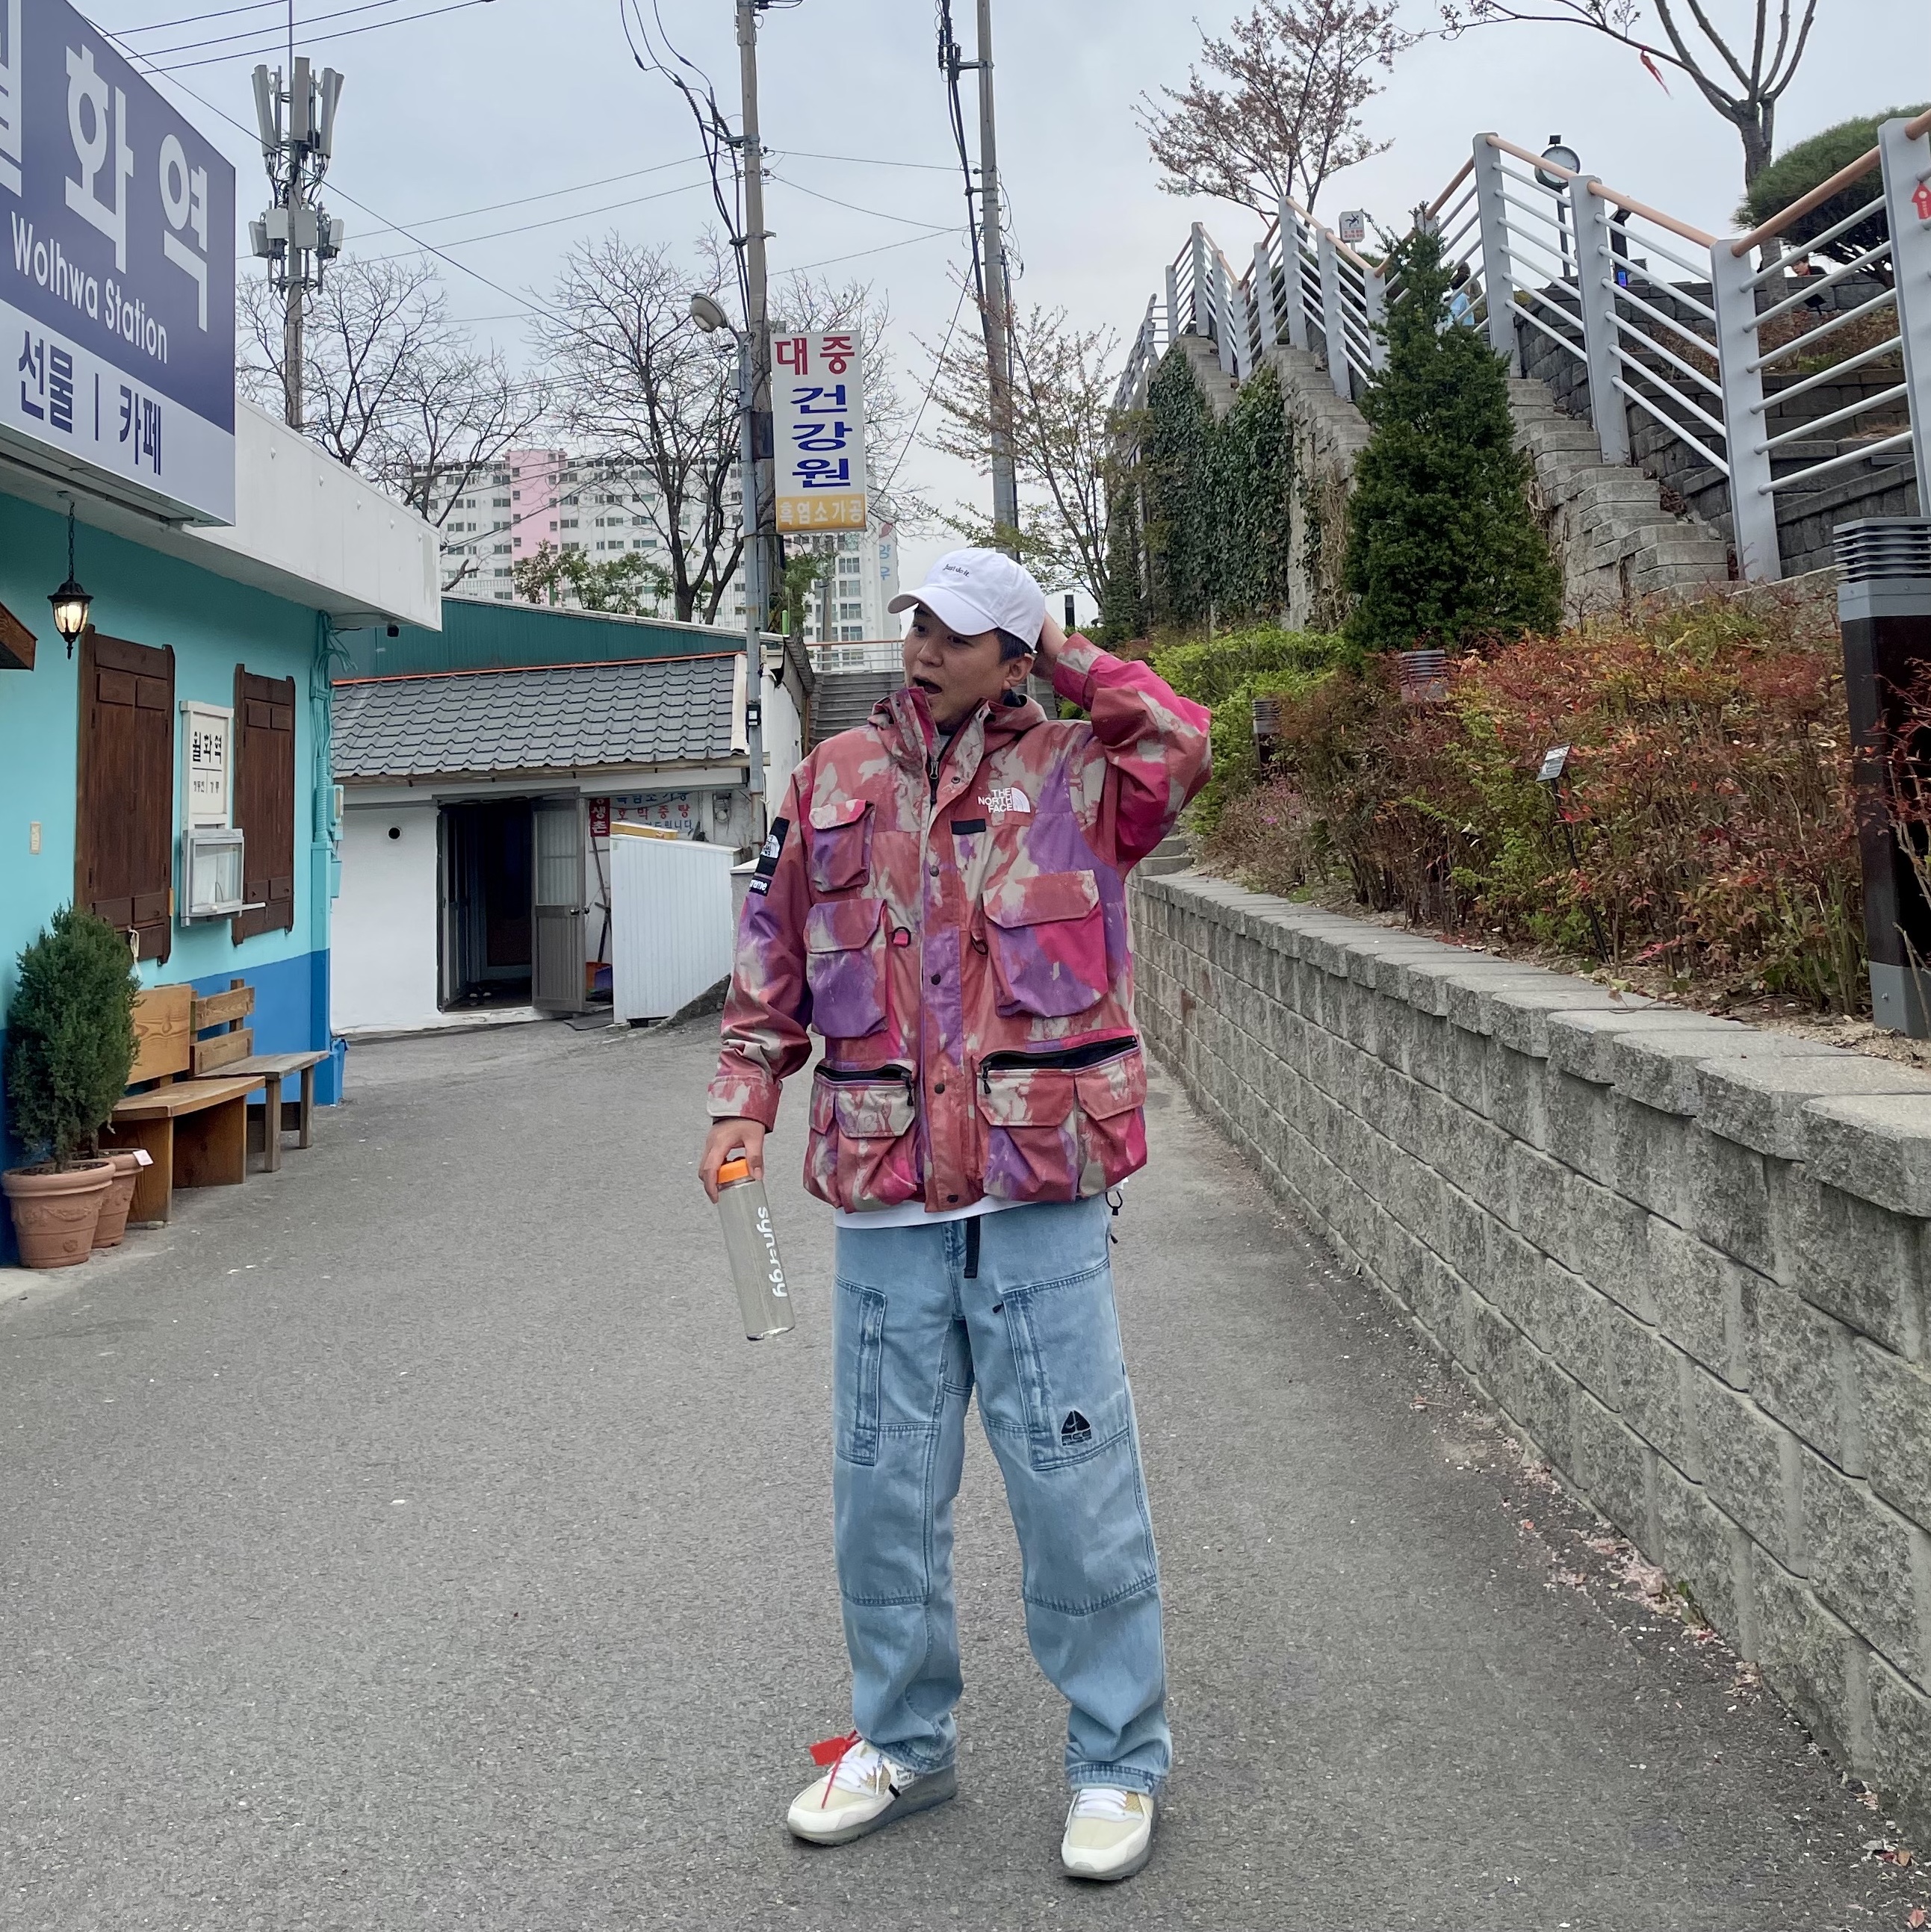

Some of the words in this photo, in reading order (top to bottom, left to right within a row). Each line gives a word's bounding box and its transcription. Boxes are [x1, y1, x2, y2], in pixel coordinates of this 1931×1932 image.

[0, 0, 208, 332] 화역
[11, 210, 98, 320] Wolhwa
[105, 278, 167, 364] Station
[774, 335, 855, 376] 대중
[19, 330, 73, 434] 선물
[120, 384, 161, 476] 카페
[790, 384, 853, 488] 건강원
[779, 500, 863, 526] 흑염소가공
[192, 730, 222, 765] 월화역
[977, 795, 1013, 806] NORTH
[988, 804, 1013, 813] FACE
[991, 787, 1011, 798] THE
[756, 1206, 788, 1298] synergy
